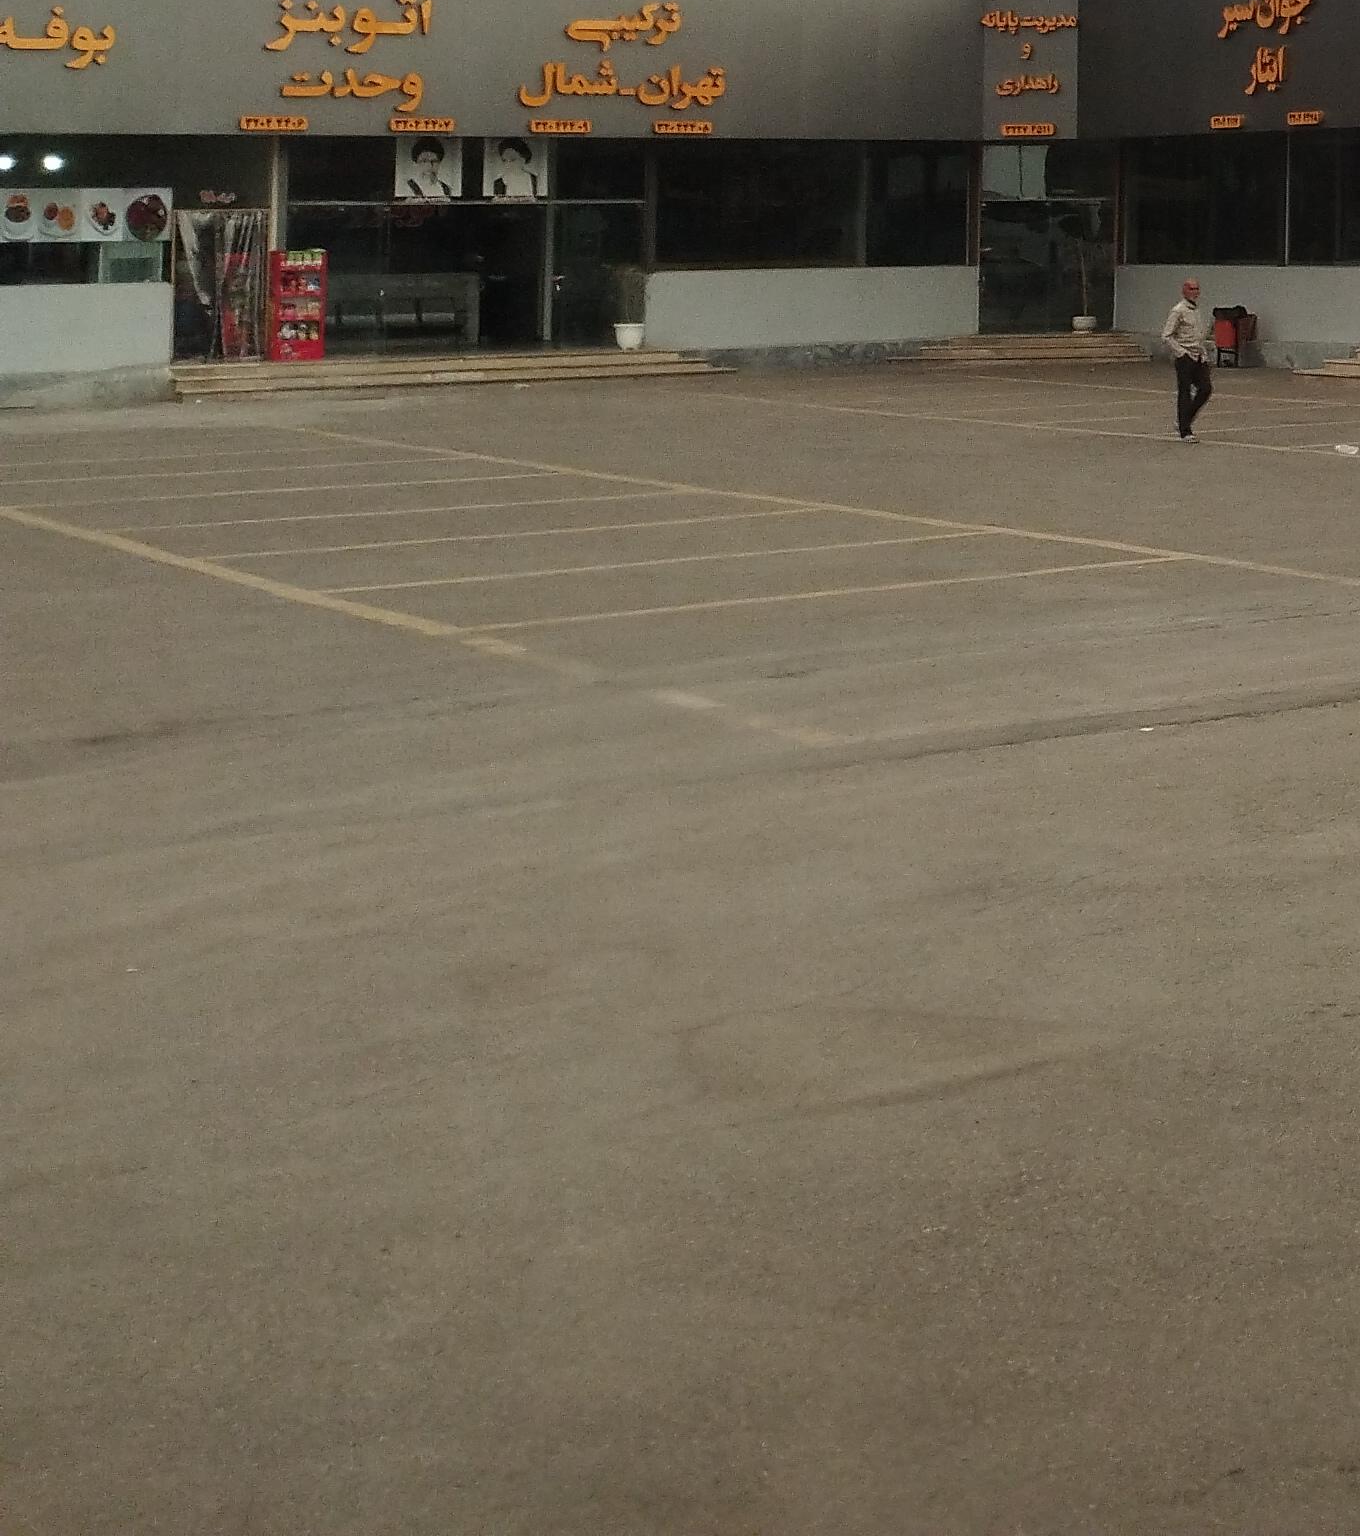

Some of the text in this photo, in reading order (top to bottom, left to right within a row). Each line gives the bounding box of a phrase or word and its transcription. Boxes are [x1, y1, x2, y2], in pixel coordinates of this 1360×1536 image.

[564, 0, 682, 52] ترکیبی
[981, 9, 1077, 34] مدیریت پایانه
[1217, 0, 1254, 38] سیر
[1020, 43, 1033, 60] و
[1244, 45, 1286, 94] ایثار
[281, 67, 424, 112] وحدت
[996, 75, 1060, 96] راهداری
